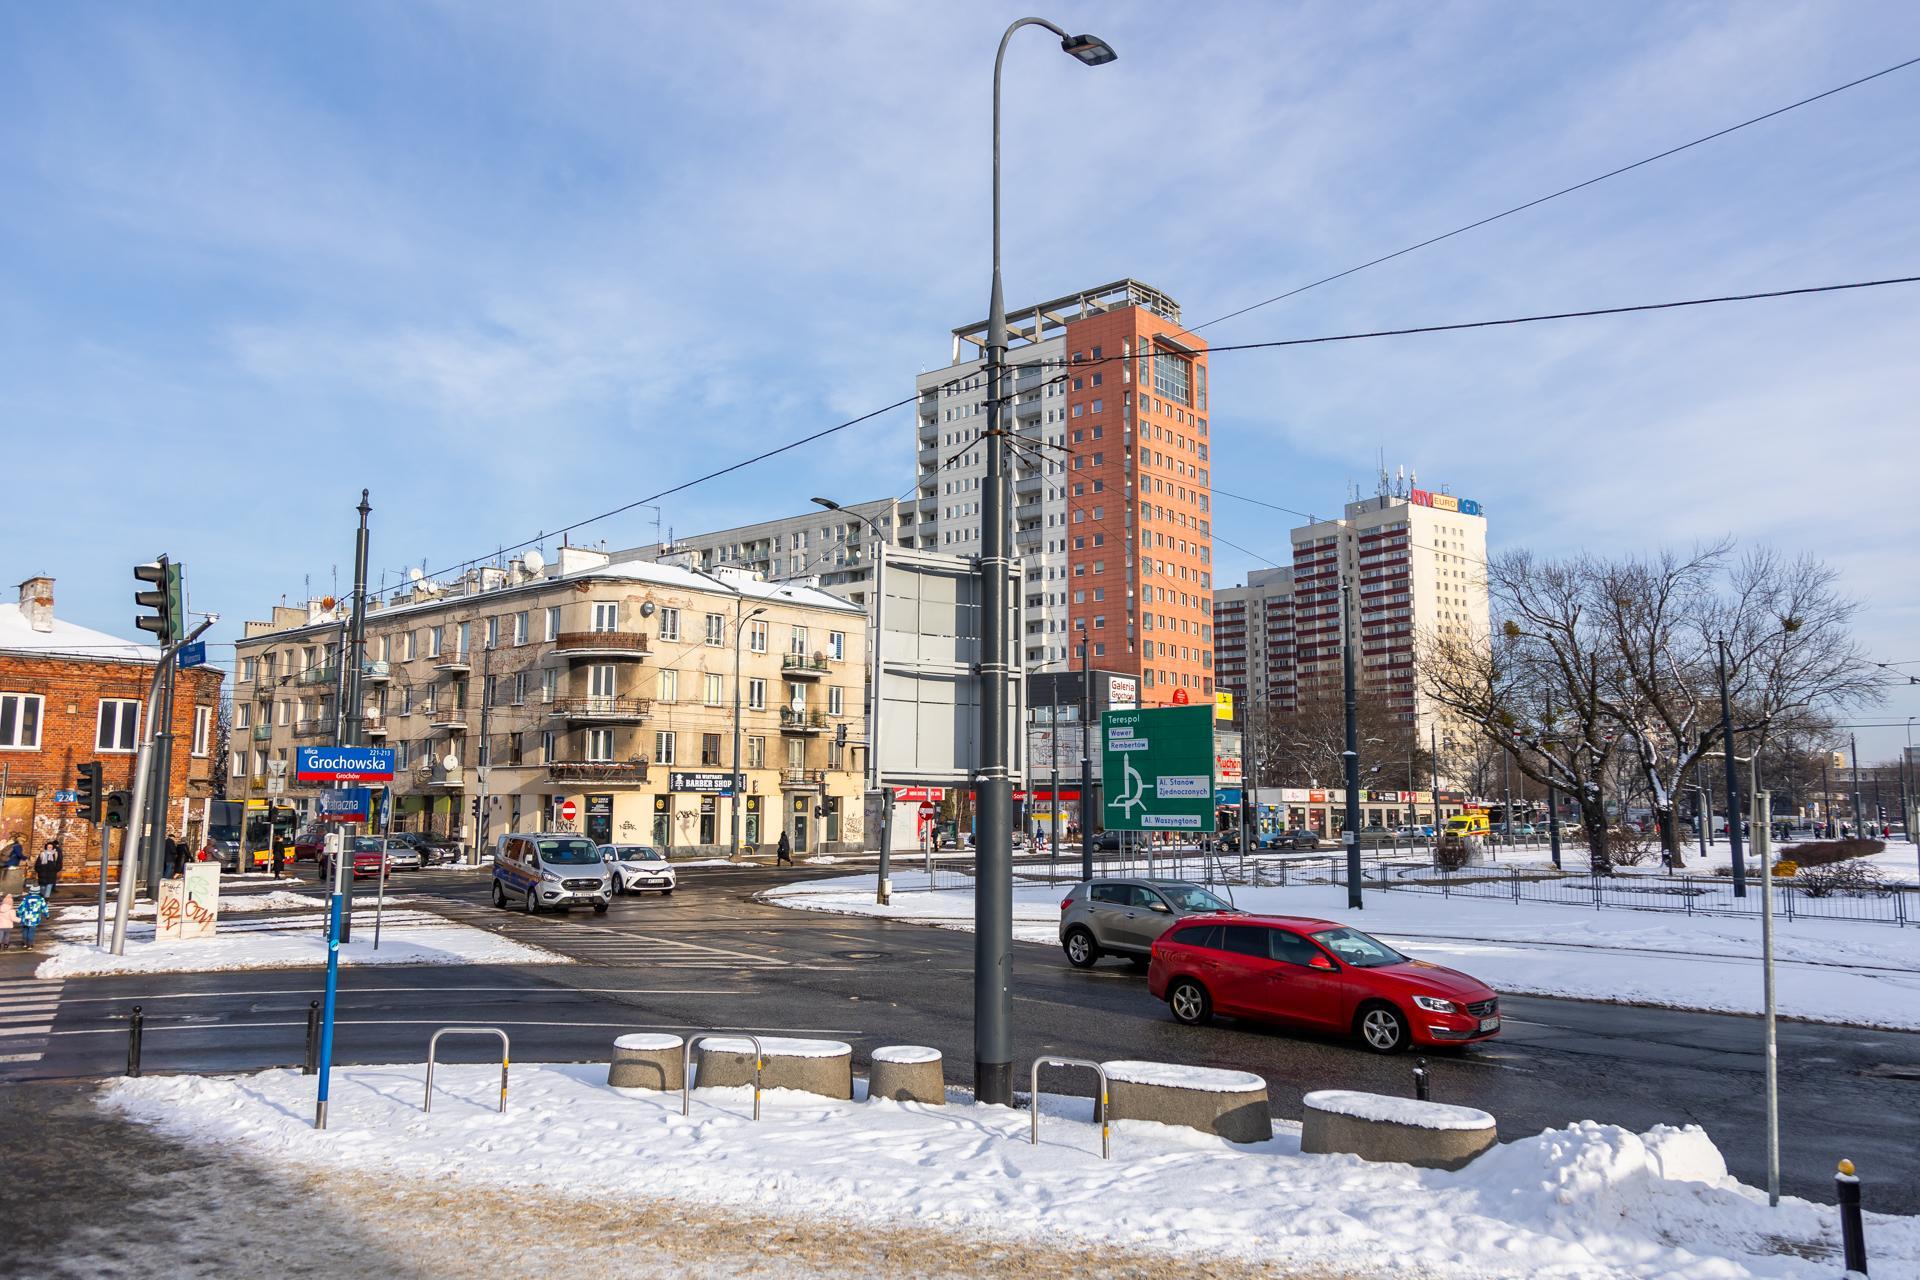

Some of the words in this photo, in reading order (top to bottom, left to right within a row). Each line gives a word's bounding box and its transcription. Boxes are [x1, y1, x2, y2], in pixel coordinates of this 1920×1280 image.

[1434, 497, 1456, 508] EURO
[1111, 680, 1135, 691] Galeria
[1108, 714, 1140, 725] Terespol
[1110, 729, 1132, 737] Wawer
[308, 755, 386, 770] Grochowska
[685, 779, 713, 788] BARBER
[714, 780, 732, 788] SHOP
[1159, 778, 1167, 786] Al.
[1159, 788, 1208, 796] Zjednoczonych
[1154, 816, 1198, 825] Waszyngtona
